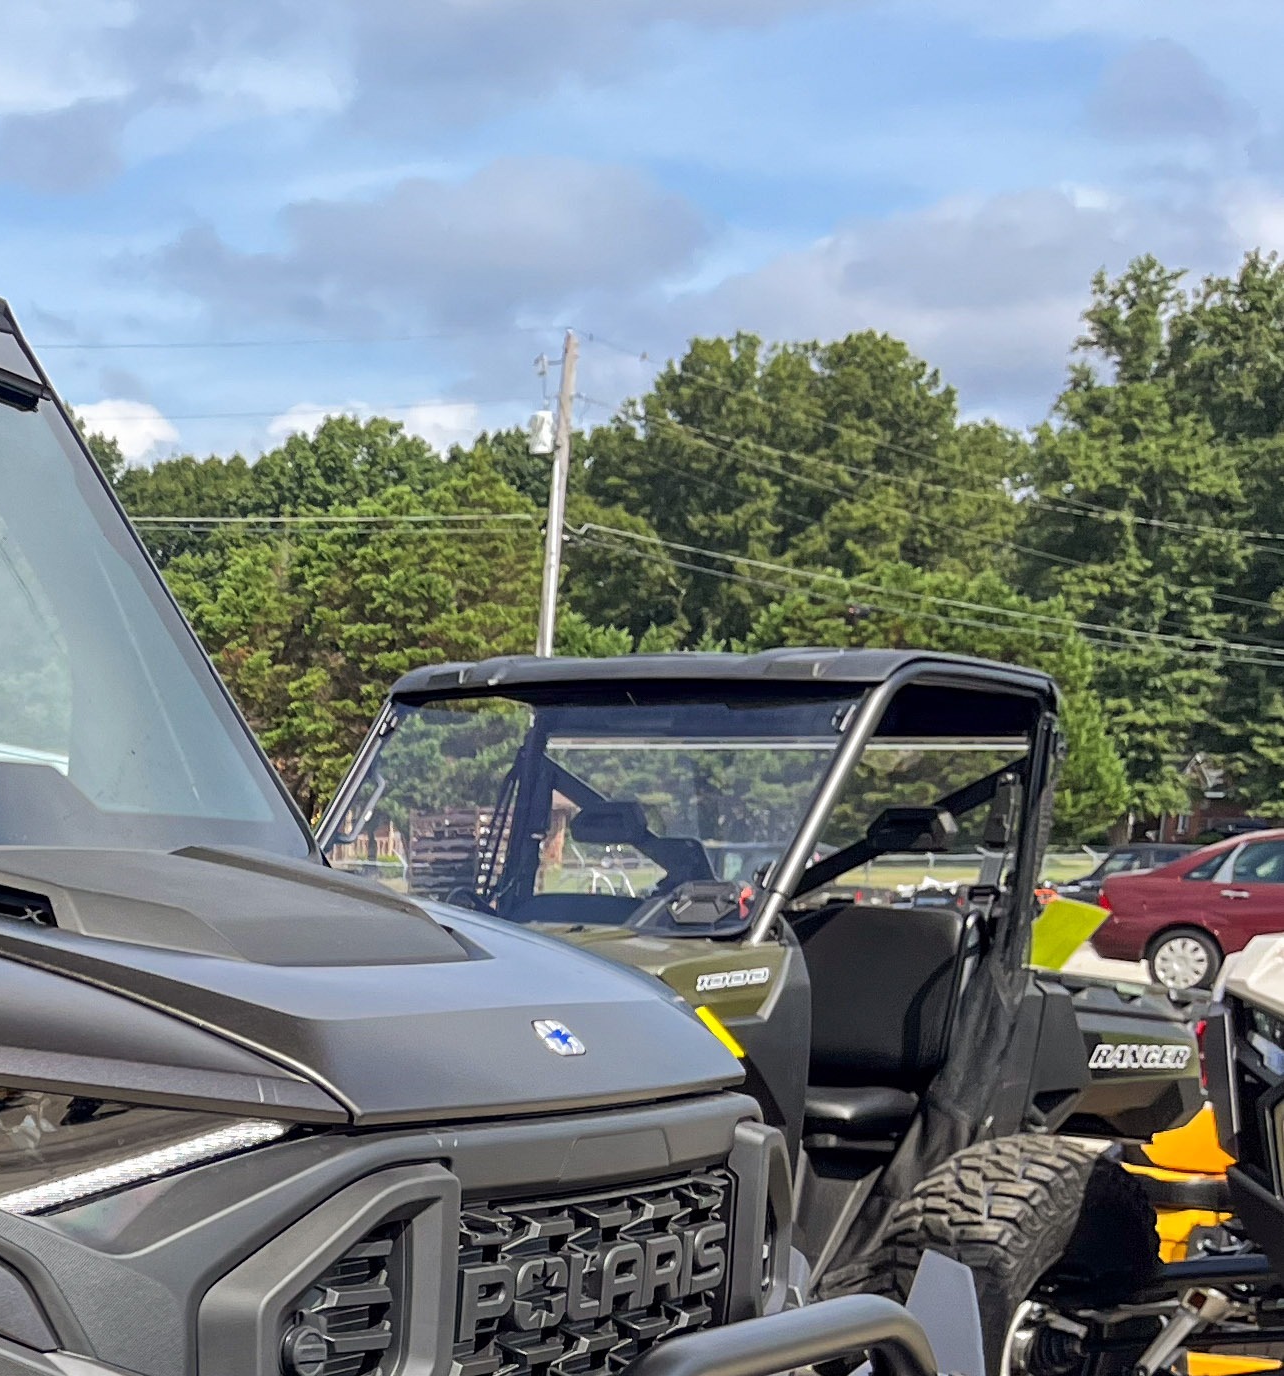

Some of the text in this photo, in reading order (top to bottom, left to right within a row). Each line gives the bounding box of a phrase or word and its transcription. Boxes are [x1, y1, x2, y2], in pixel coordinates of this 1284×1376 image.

[696, 966, 770, 992] 1000
[1088, 1043, 1192, 1070] RANGER
[457, 1220, 727, 1342] POLARIS
